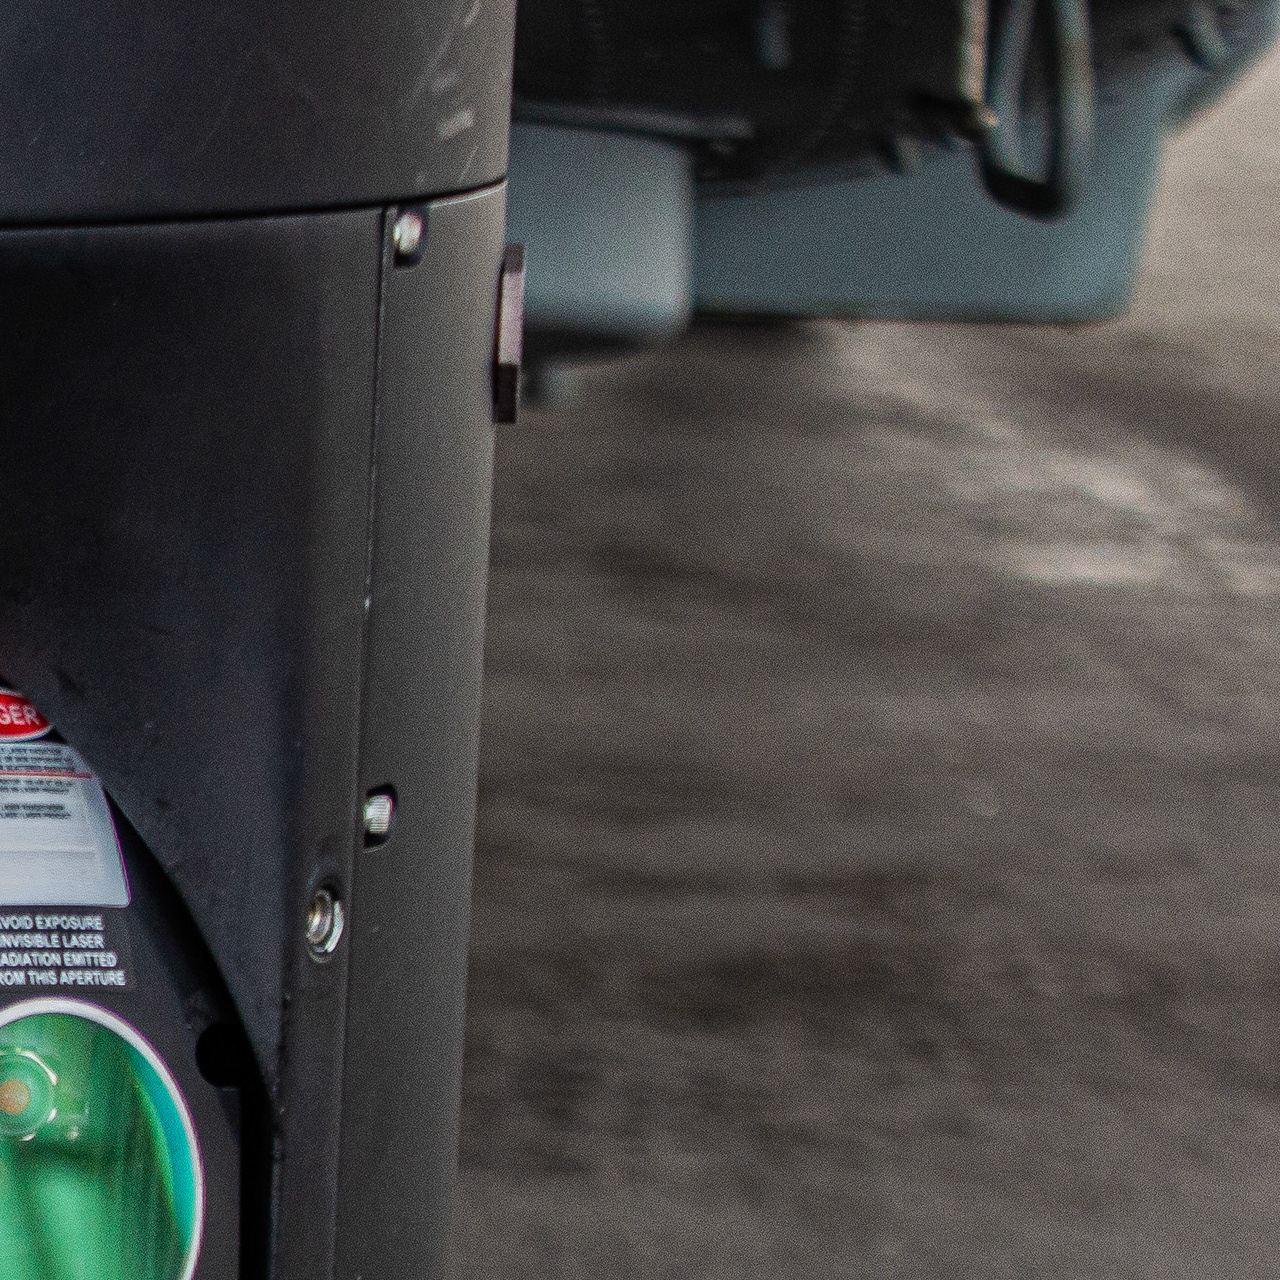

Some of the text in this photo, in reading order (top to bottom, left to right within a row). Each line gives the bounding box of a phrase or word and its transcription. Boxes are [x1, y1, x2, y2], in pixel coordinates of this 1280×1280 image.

[35, 914, 104, 931] EXPOSURE
[62, 933, 105, 949] LASER
[63, 951, 118, 968] EMITTED
[27, 970, 58, 986] THIS
[59, 970, 126, 986] APERTURE
